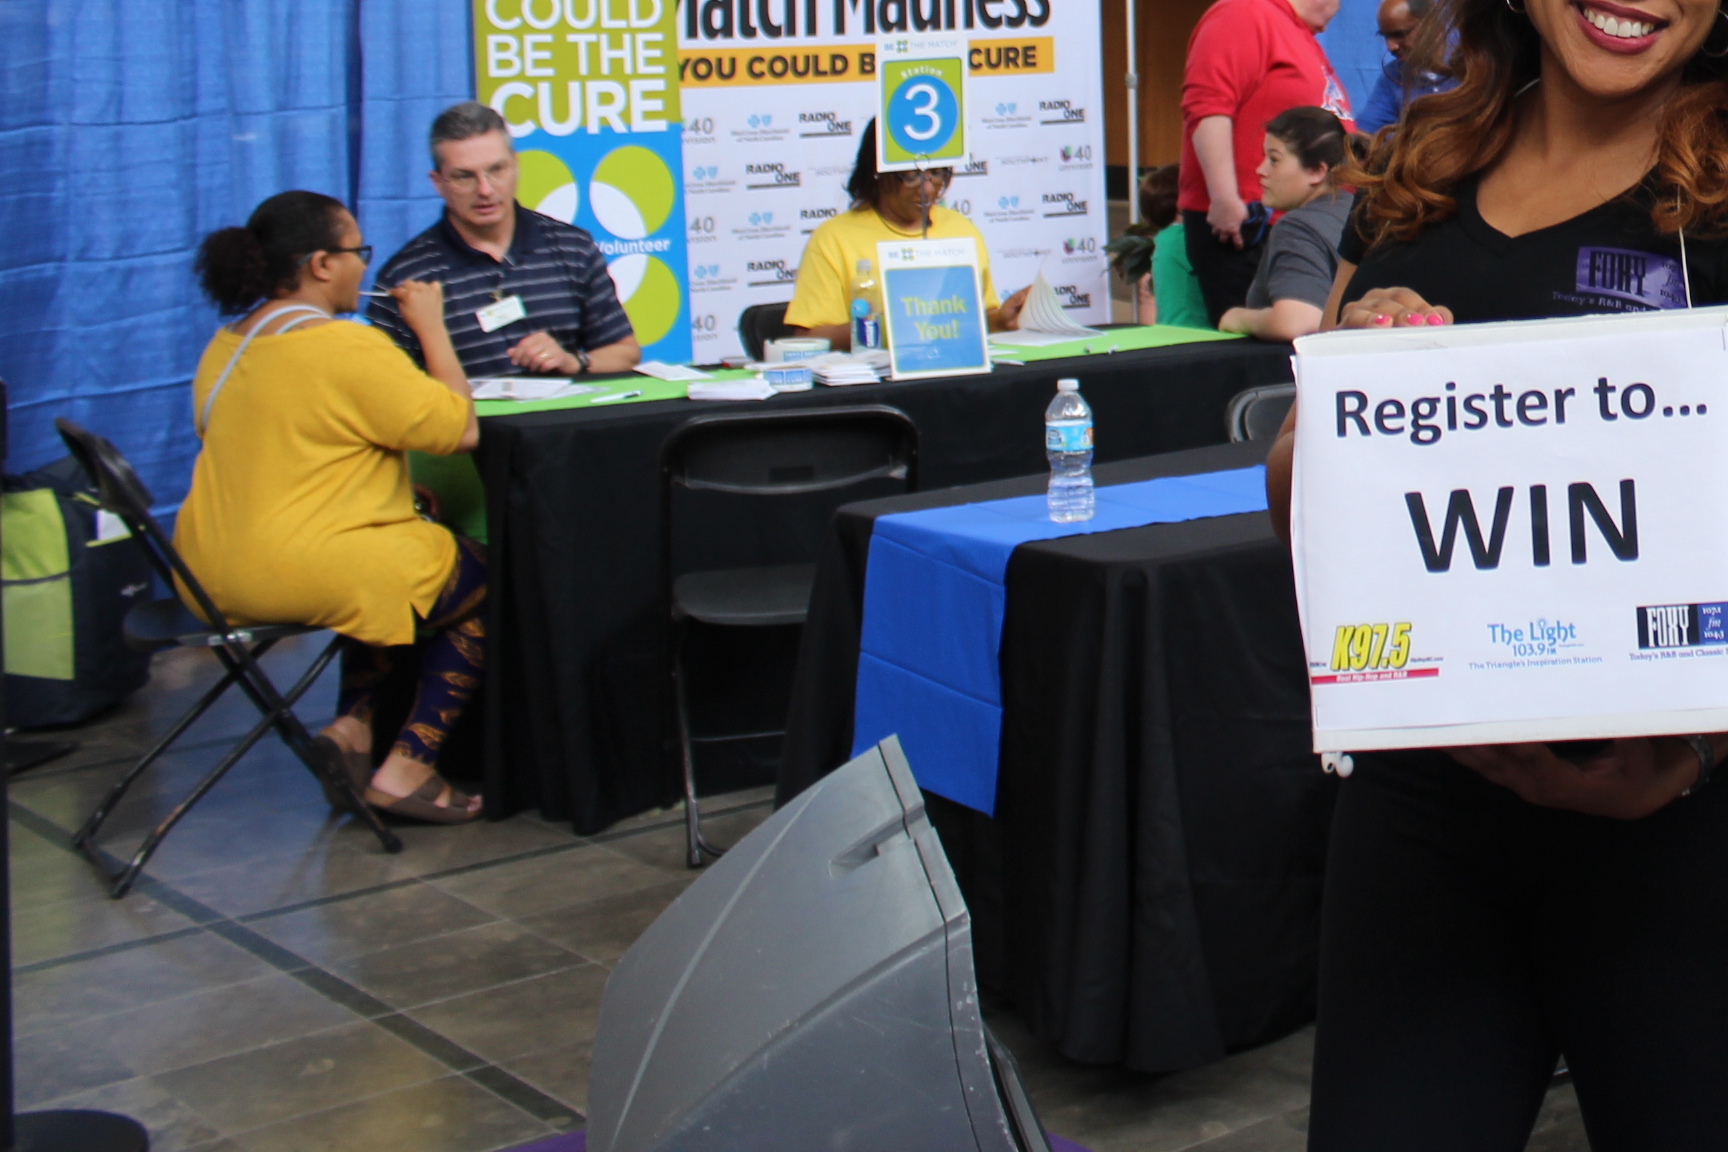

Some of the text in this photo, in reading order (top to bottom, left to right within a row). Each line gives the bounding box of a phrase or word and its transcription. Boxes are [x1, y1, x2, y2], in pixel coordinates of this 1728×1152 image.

[487, 33, 666, 78] BE THE
[746, 53, 848, 80] COULD
[859, 53, 875, 75] B
[968, 46, 1037, 72] CURE
[489, 79, 668, 138] CURE
[904, 83, 941, 141] 3
[689, 117, 714, 134] 40
[1074, 145, 1092, 161] 40
[690, 216, 715, 233] 40
[1077, 237, 1096, 253] 40
[1589, 250, 1648, 297] FOXY
[901, 295, 968, 317] Thank
[1598, 297, 1622, 309] R&B
[692, 314, 716, 331] 40
[914, 320, 960, 341] You!
[1335, 377, 1708, 446] Register to...
[1404, 478, 1639, 573] WIN
[1487, 616, 1577, 647] The Light
[1645, 605, 1690, 648] FOXY
[1330, 622, 1412, 671] K97.5
[1512, 643, 1546, 657] 103.9
[1629, 652, 1659, 662] Today's
[1660, 650, 1677, 659] R&B
[1679, 649, 1694, 658] and
[1695, 648, 1724, 657] Classic
[1468, 656, 1603, 670] The Triangle's Inspiration Station
